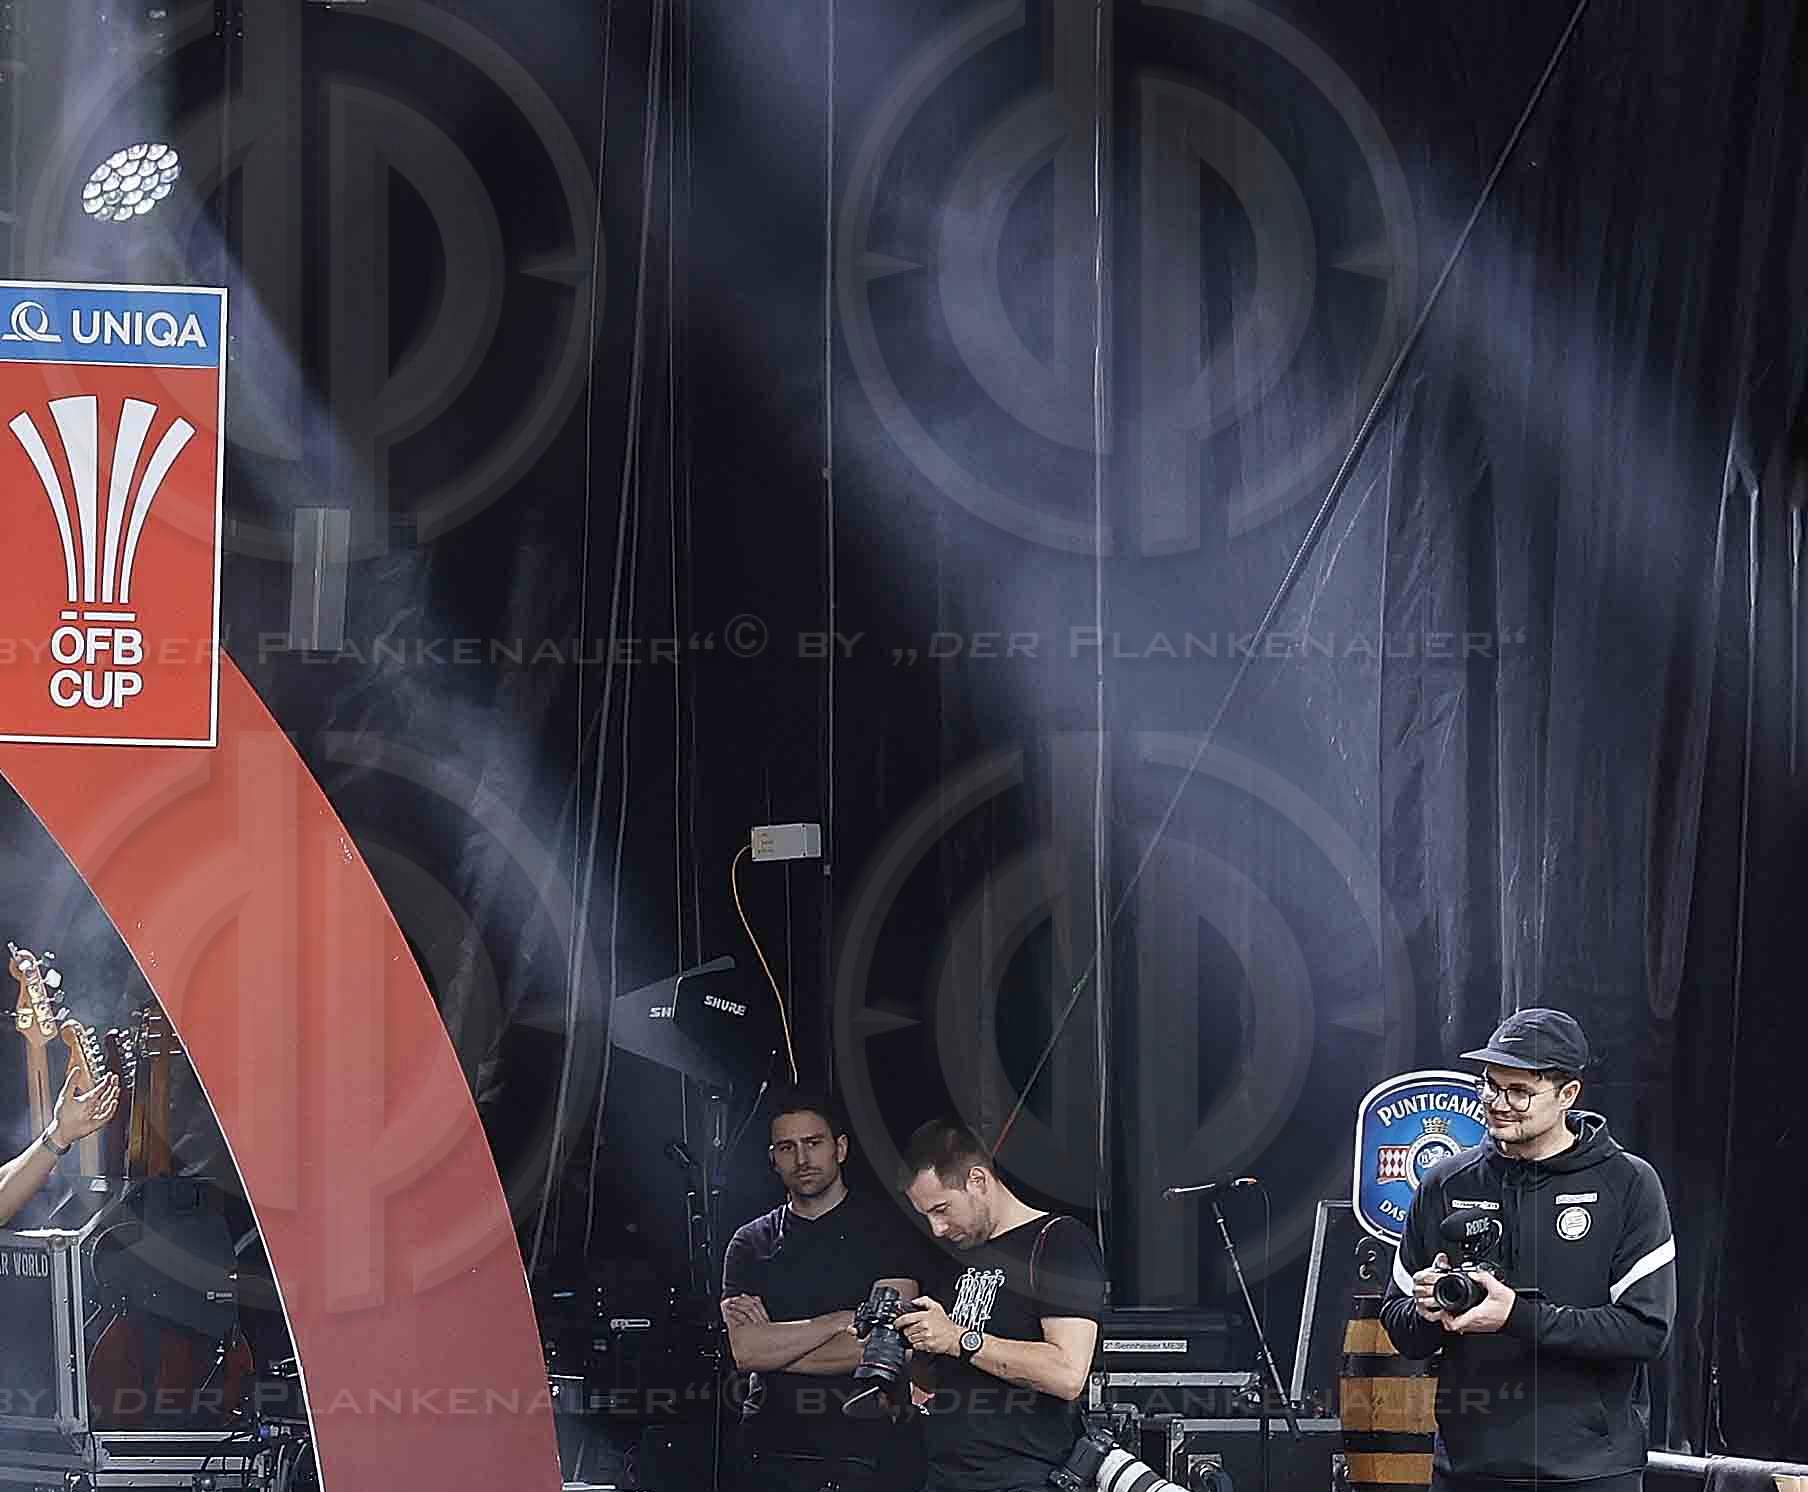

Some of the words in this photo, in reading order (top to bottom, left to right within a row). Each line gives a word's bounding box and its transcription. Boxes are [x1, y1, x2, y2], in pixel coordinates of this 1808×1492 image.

[73, 311, 207, 350] UNIQA
[51, 669, 143, 708] CUP
[704, 995, 746, 1016] SHURE
[1377, 1093, 1489, 1127] PUNTIGAME
[1379, 1200, 1406, 1222] DAS
[13, 1251, 48, 1277] WORLD
